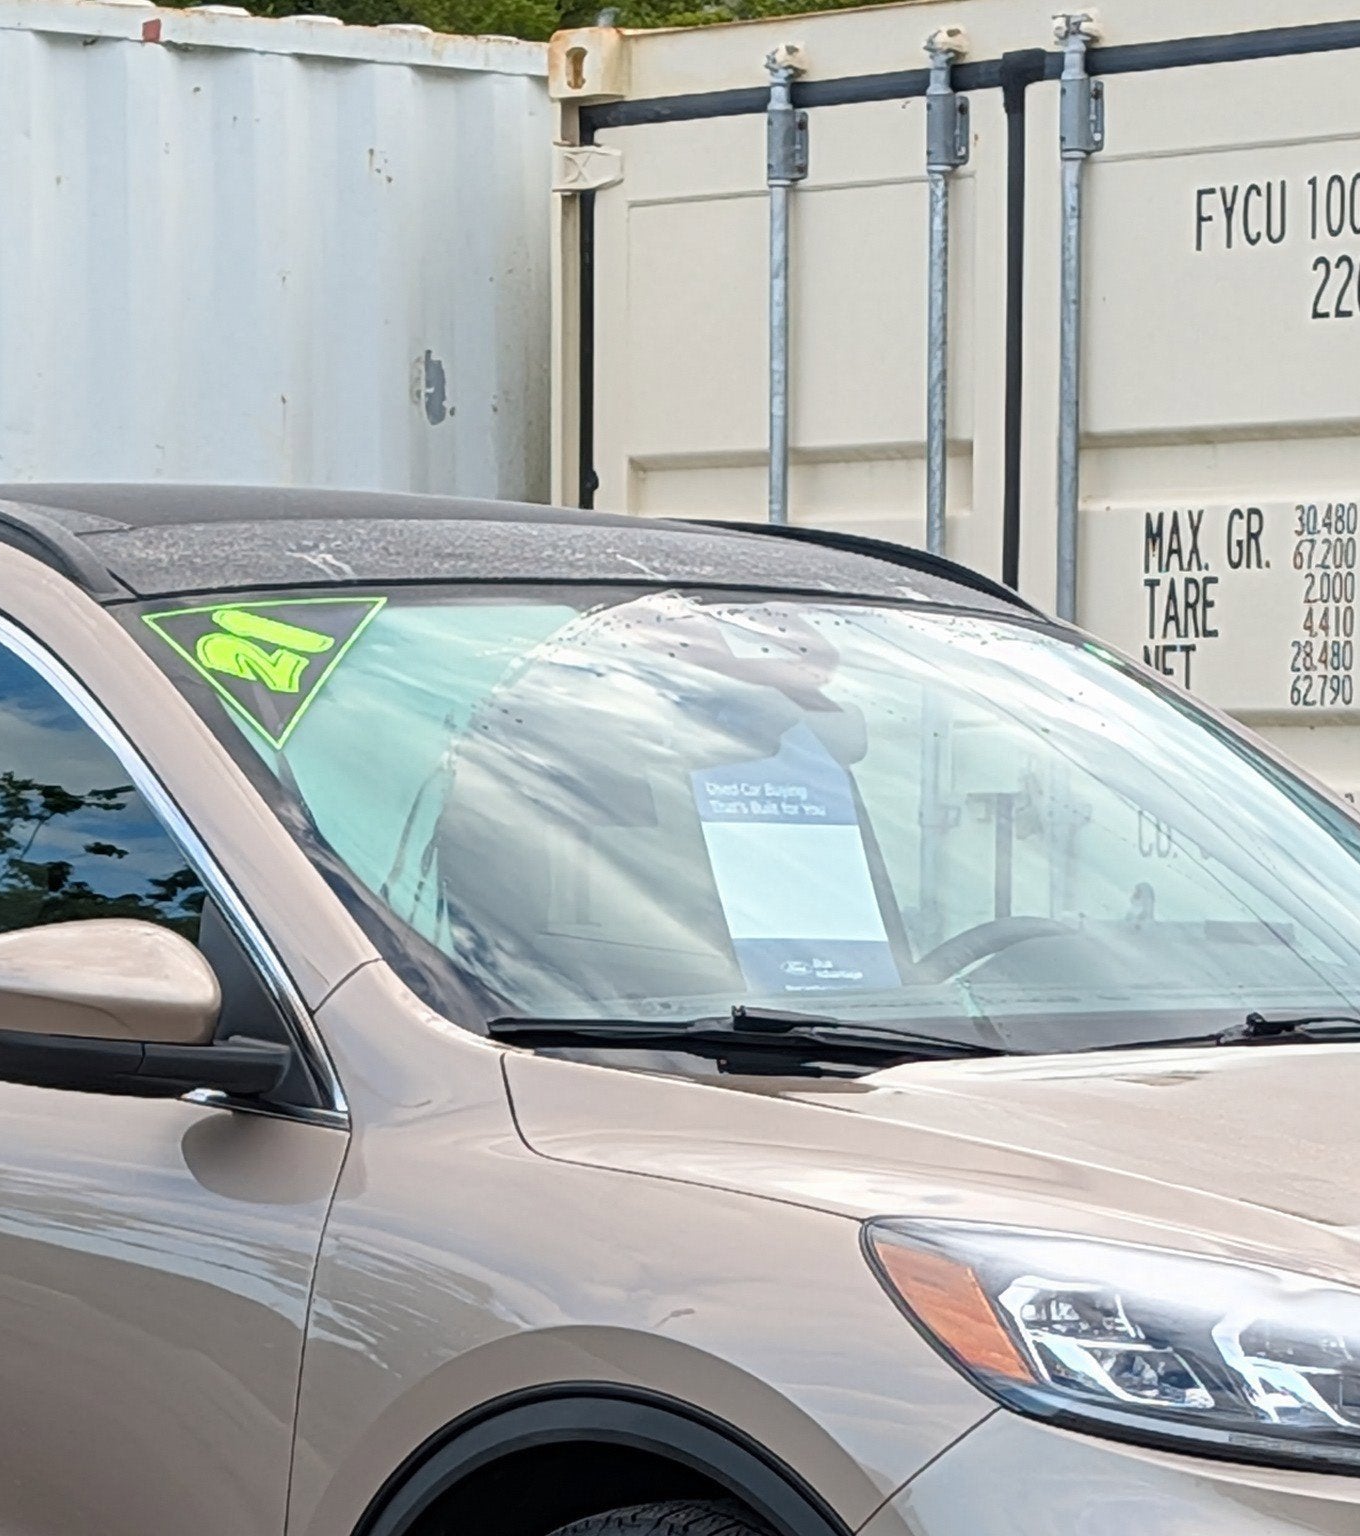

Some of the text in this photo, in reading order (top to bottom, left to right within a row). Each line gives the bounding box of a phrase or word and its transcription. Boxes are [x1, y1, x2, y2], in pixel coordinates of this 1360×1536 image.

[1195, 179, 1287, 252] FYCU
[1226, 506, 1271, 570] GR.
[1143, 576, 1220, 640] TARE
